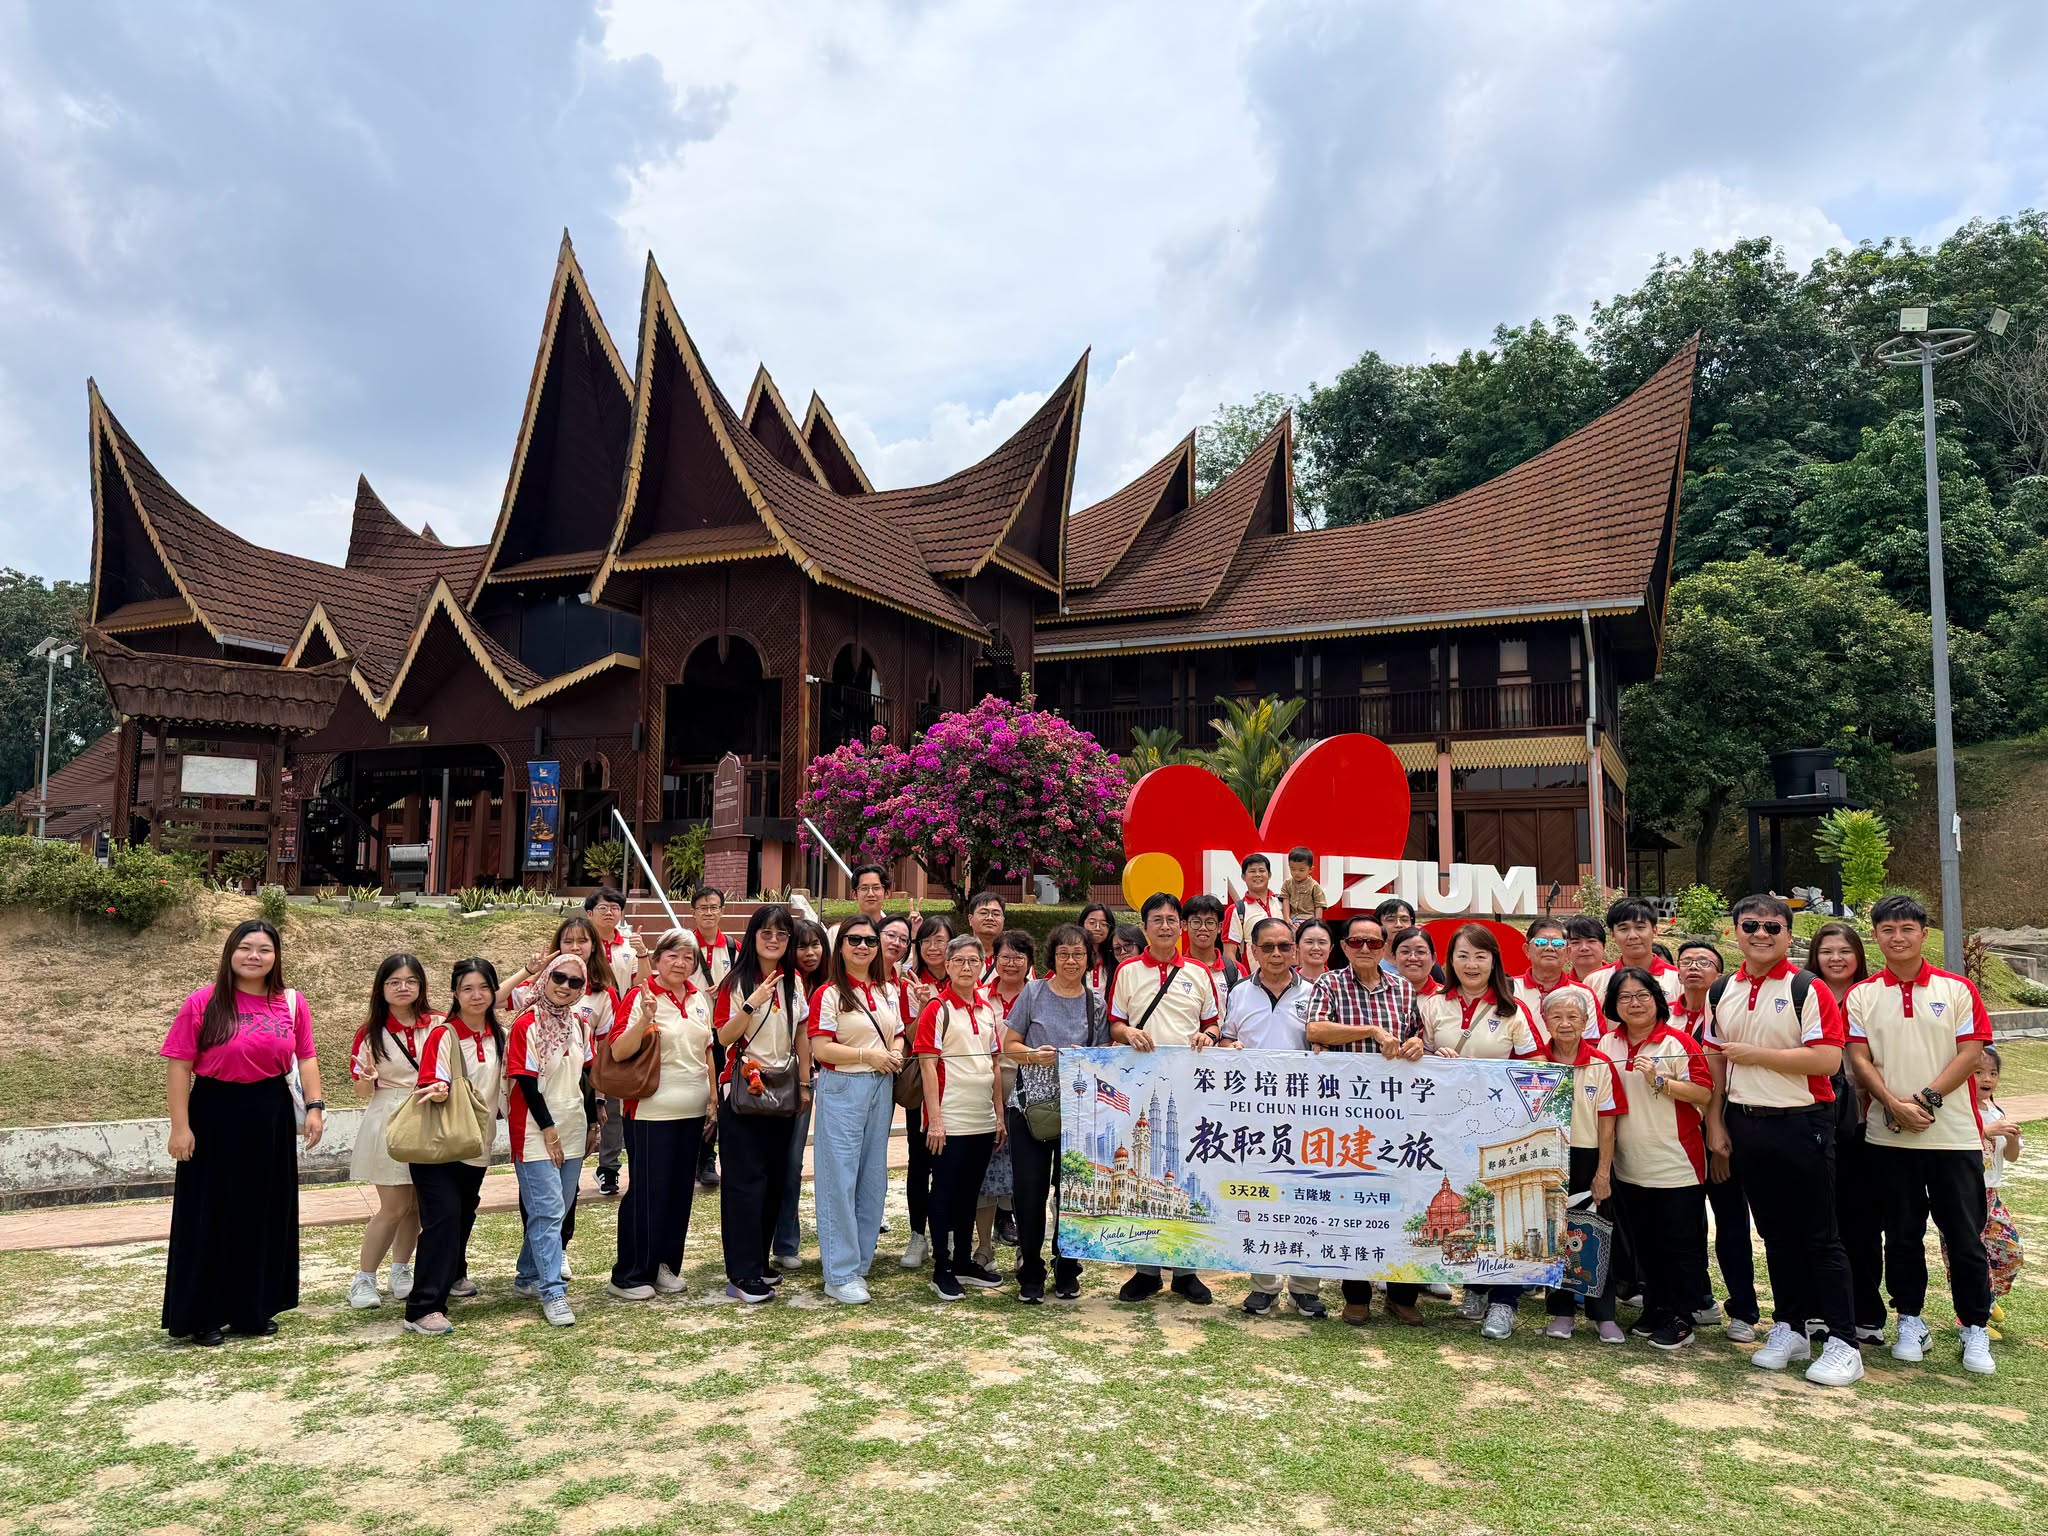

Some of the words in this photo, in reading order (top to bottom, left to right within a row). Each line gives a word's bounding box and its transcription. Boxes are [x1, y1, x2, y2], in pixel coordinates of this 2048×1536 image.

[1193, 1067, 1436, 1104] 笨珍培群独立中学
[1229, 1101, 1251, 1113] PEI
[1256, 1102, 1296, 1115] CHUN
[1302, 1105, 1339, 1117] HIGH
[1345, 1106, 1405, 1120] SCHOOL
[1185, 1116, 1444, 1171] 教职员团建之旅
[1229, 1184, 1270, 1198] 3天2夜
[1293, 1188, 1332, 1202] 吉隆坡
[1353, 1191, 1391, 1205] 马六甲
[1257, 1213, 1269, 1222] 25
[1272, 1214, 1291, 1224] SEP
[1294, 1215, 1318, 1226] 2026
[1328, 1217, 1340, 1227] 27
[1343, 1218, 1362, 1228] SEP
[1365, 1220, 1390, 1230] 2026
[1100, 1226, 1126, 1241] Kuala
[1129, 1224, 1162, 1241] Lumpur
[1477, 1257, 1516, 1274] Melaka
